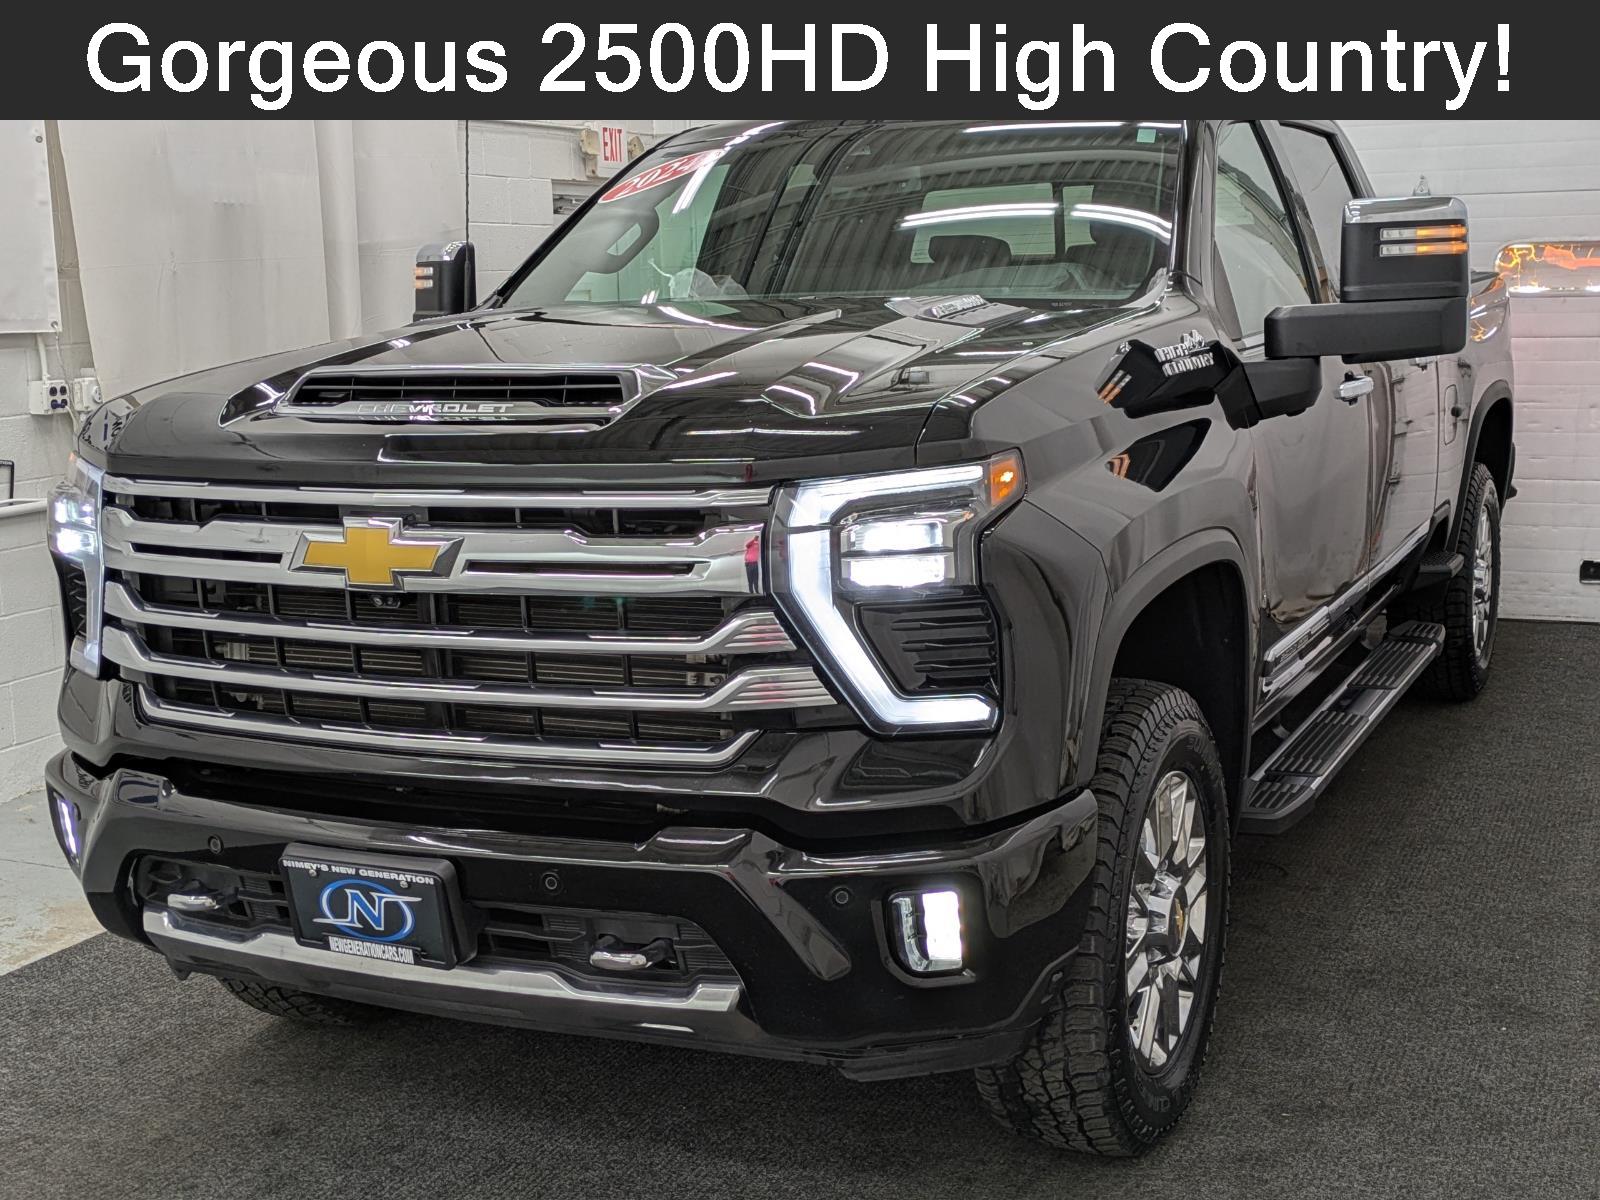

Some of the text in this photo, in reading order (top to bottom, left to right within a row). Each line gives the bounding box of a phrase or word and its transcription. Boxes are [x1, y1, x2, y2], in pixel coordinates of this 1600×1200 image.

[602, 127, 622, 162] EXIT
[357, 402, 514, 414] CHEVROLET
[282, 859, 435, 885] NIMEY'S NEW GENERATION
[328, 936, 415, 965] NEWGENERATIONCARS.COM
